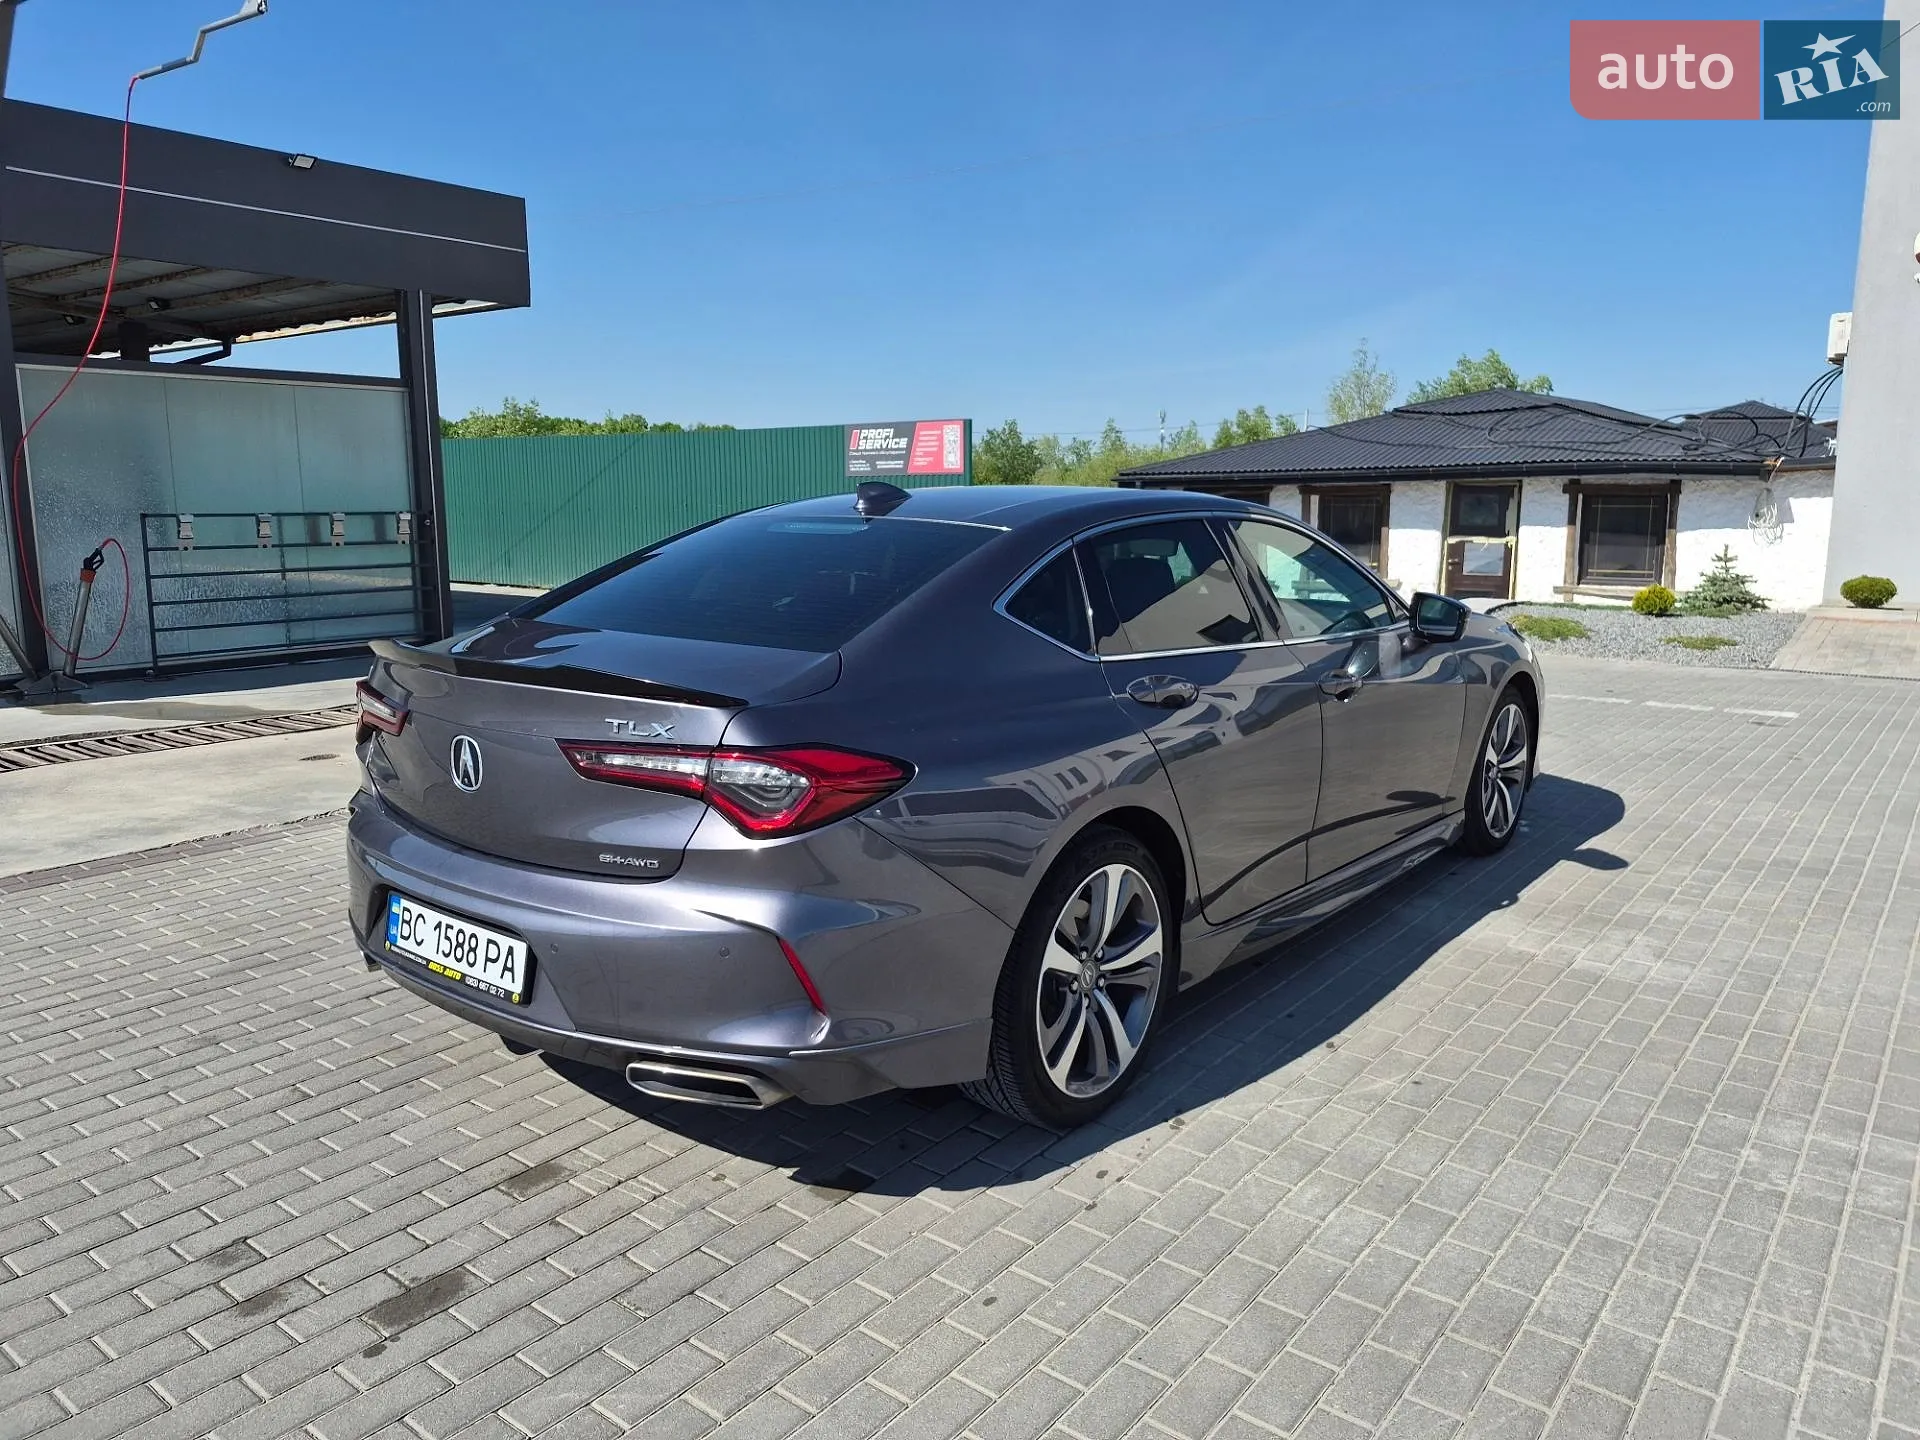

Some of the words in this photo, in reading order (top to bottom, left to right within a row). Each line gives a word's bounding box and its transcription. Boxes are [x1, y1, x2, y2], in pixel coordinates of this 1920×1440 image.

[860, 428, 894, 440] PROFI
[858, 437, 908, 450] SERVICE
[605, 718, 675, 739] TLX
[599, 854, 659, 869] SH-AWD
[400, 906, 426, 947] BC
[433, 921, 478, 968] 1588
[483, 938, 515, 983] PA
[444, 968, 461, 980] AUTO
[497, 988, 505, 998] 72
